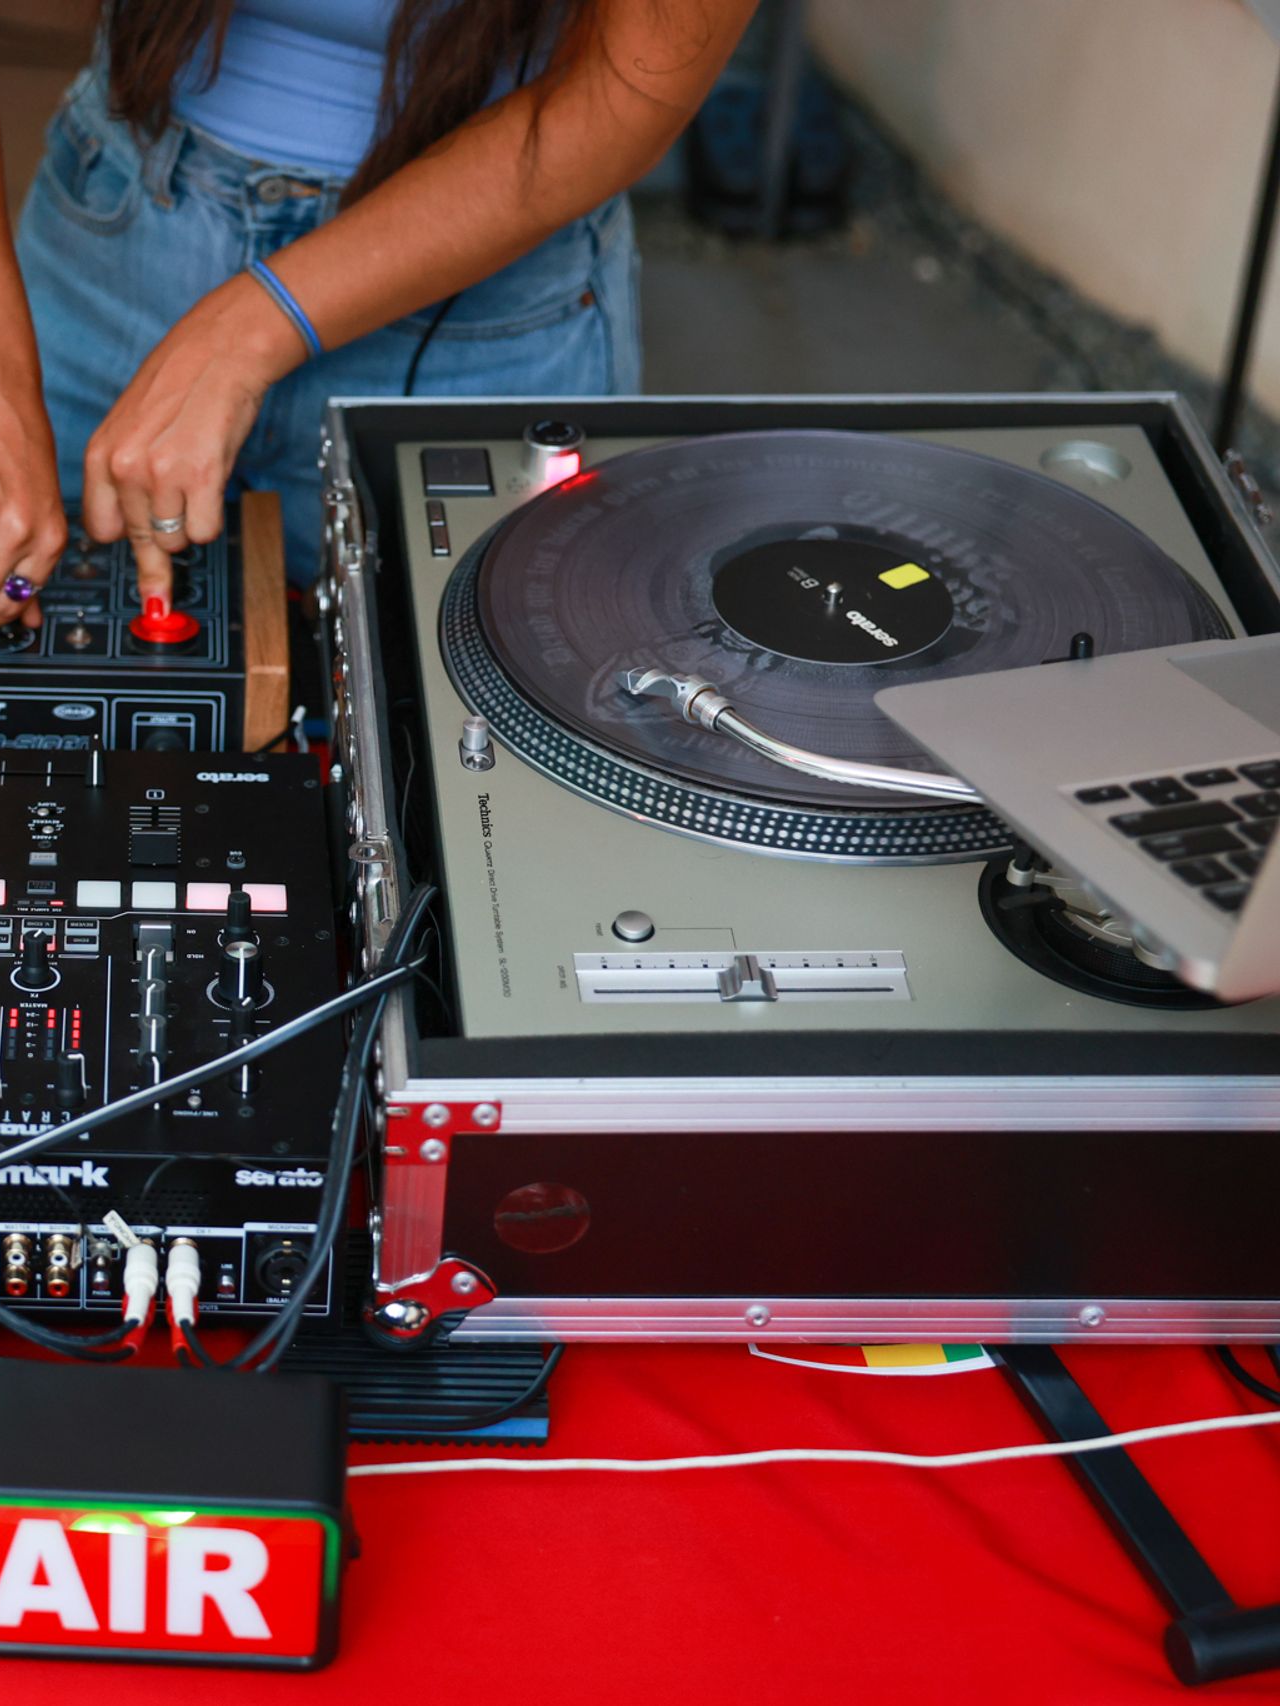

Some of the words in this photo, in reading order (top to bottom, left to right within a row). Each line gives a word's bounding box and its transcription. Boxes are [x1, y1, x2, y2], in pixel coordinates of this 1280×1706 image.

[800, 578, 819, 589] B
[846, 610, 898, 647] serato
[196, 772, 270, 783] serato
[478, 793, 492, 837] Technics
[235, 1167, 324, 1188] serato
